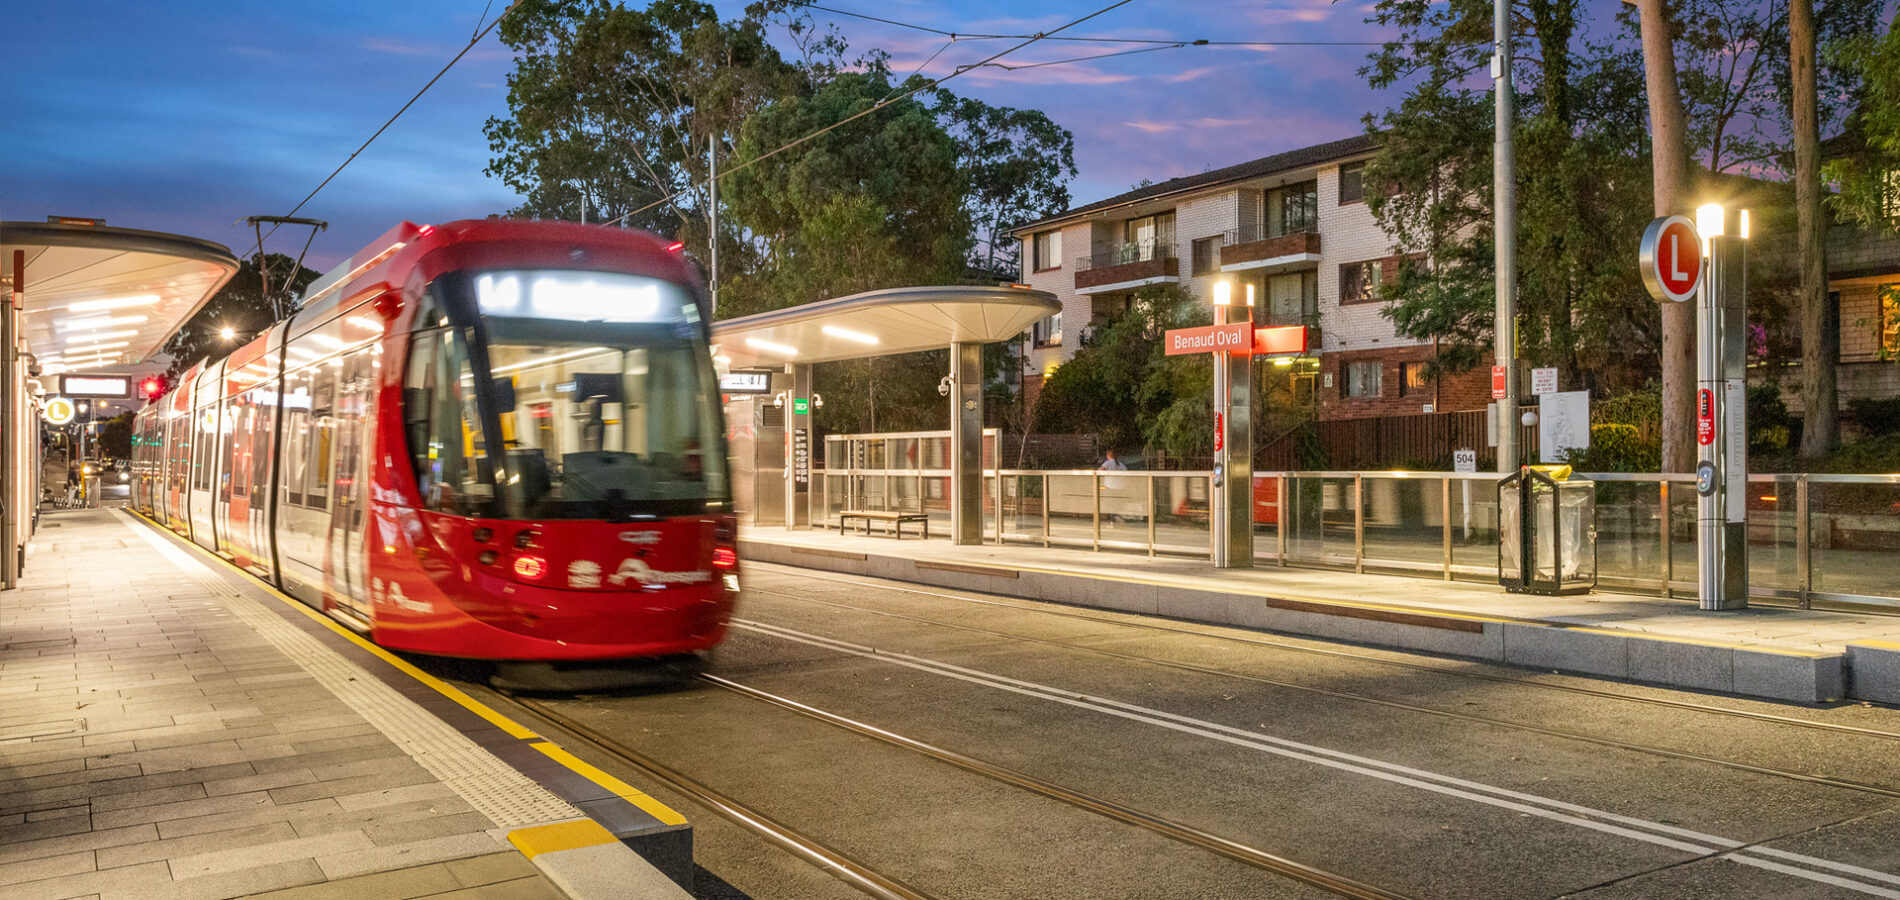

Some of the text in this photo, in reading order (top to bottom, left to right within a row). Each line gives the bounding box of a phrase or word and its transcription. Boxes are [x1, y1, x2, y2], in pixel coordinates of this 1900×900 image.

[1671, 234, 1689, 281] L
[1175, 329, 1242, 349] Benaud Oval
[53, 404, 64, 418] L
[1456, 453, 1473, 464] 504
